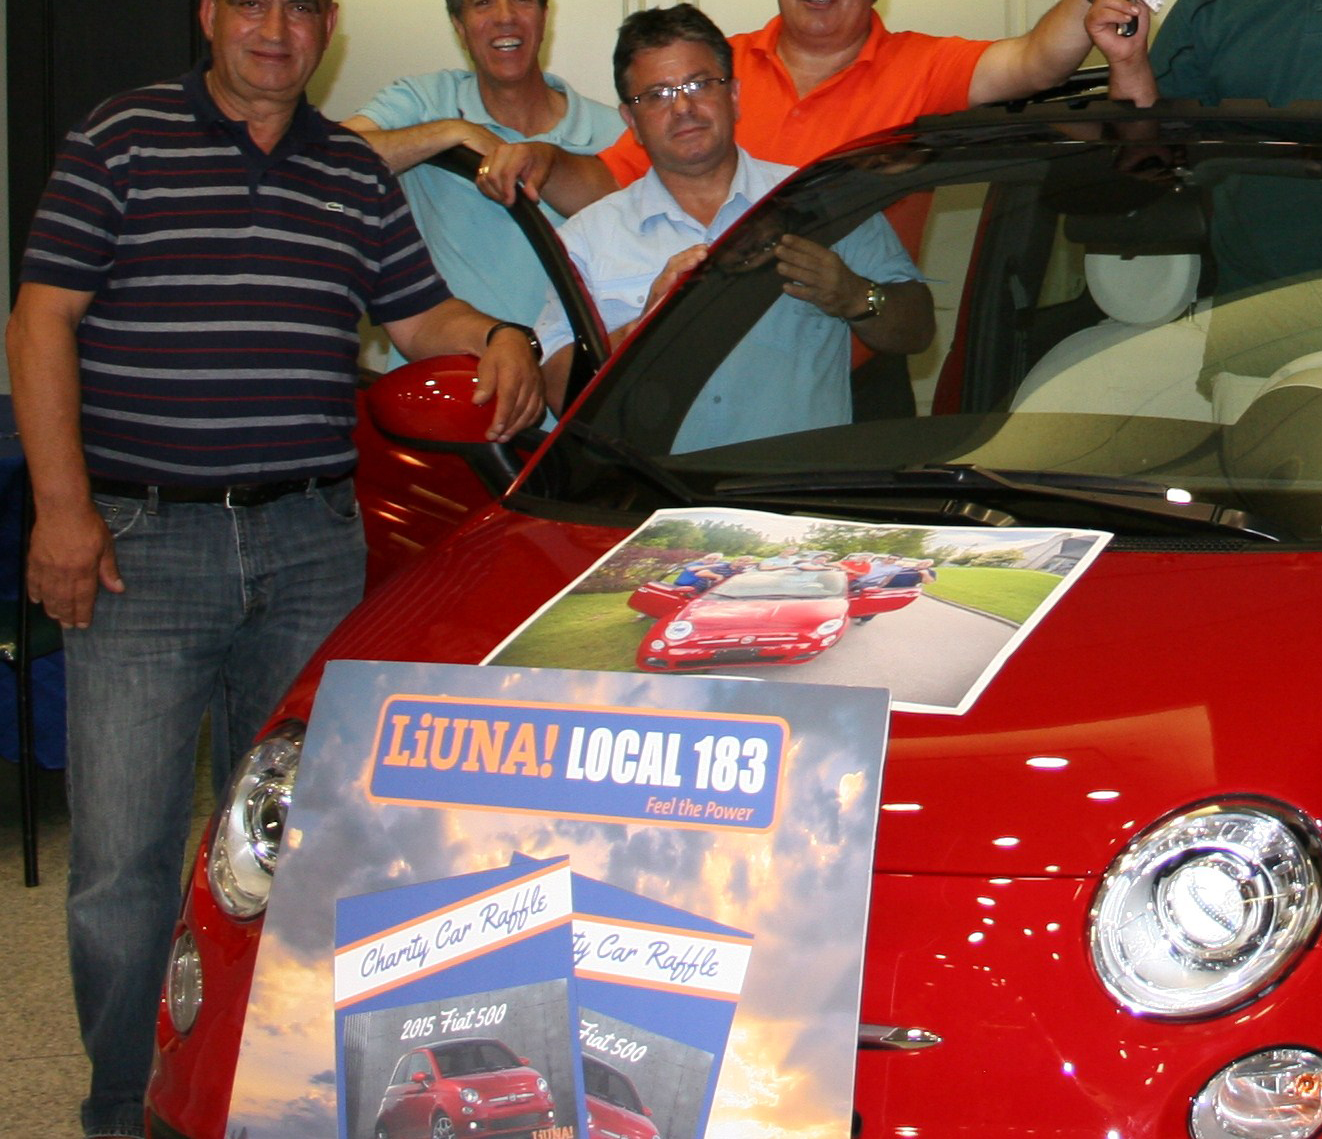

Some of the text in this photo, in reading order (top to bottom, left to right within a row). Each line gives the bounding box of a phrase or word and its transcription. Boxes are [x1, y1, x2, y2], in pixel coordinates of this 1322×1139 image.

[382, 712, 769, 794] LiUNA! LOCAL 183
[645, 795, 754, 822] Feel the Power
[360, 884, 549, 978] Charity Car Raffle
[596, 934, 639, 962] Car
[644, 939, 720, 982] Raffle
[400, 1003, 510, 1041] 2015 Fiat 500
[579, 1019, 648, 1062] Fiat 500
